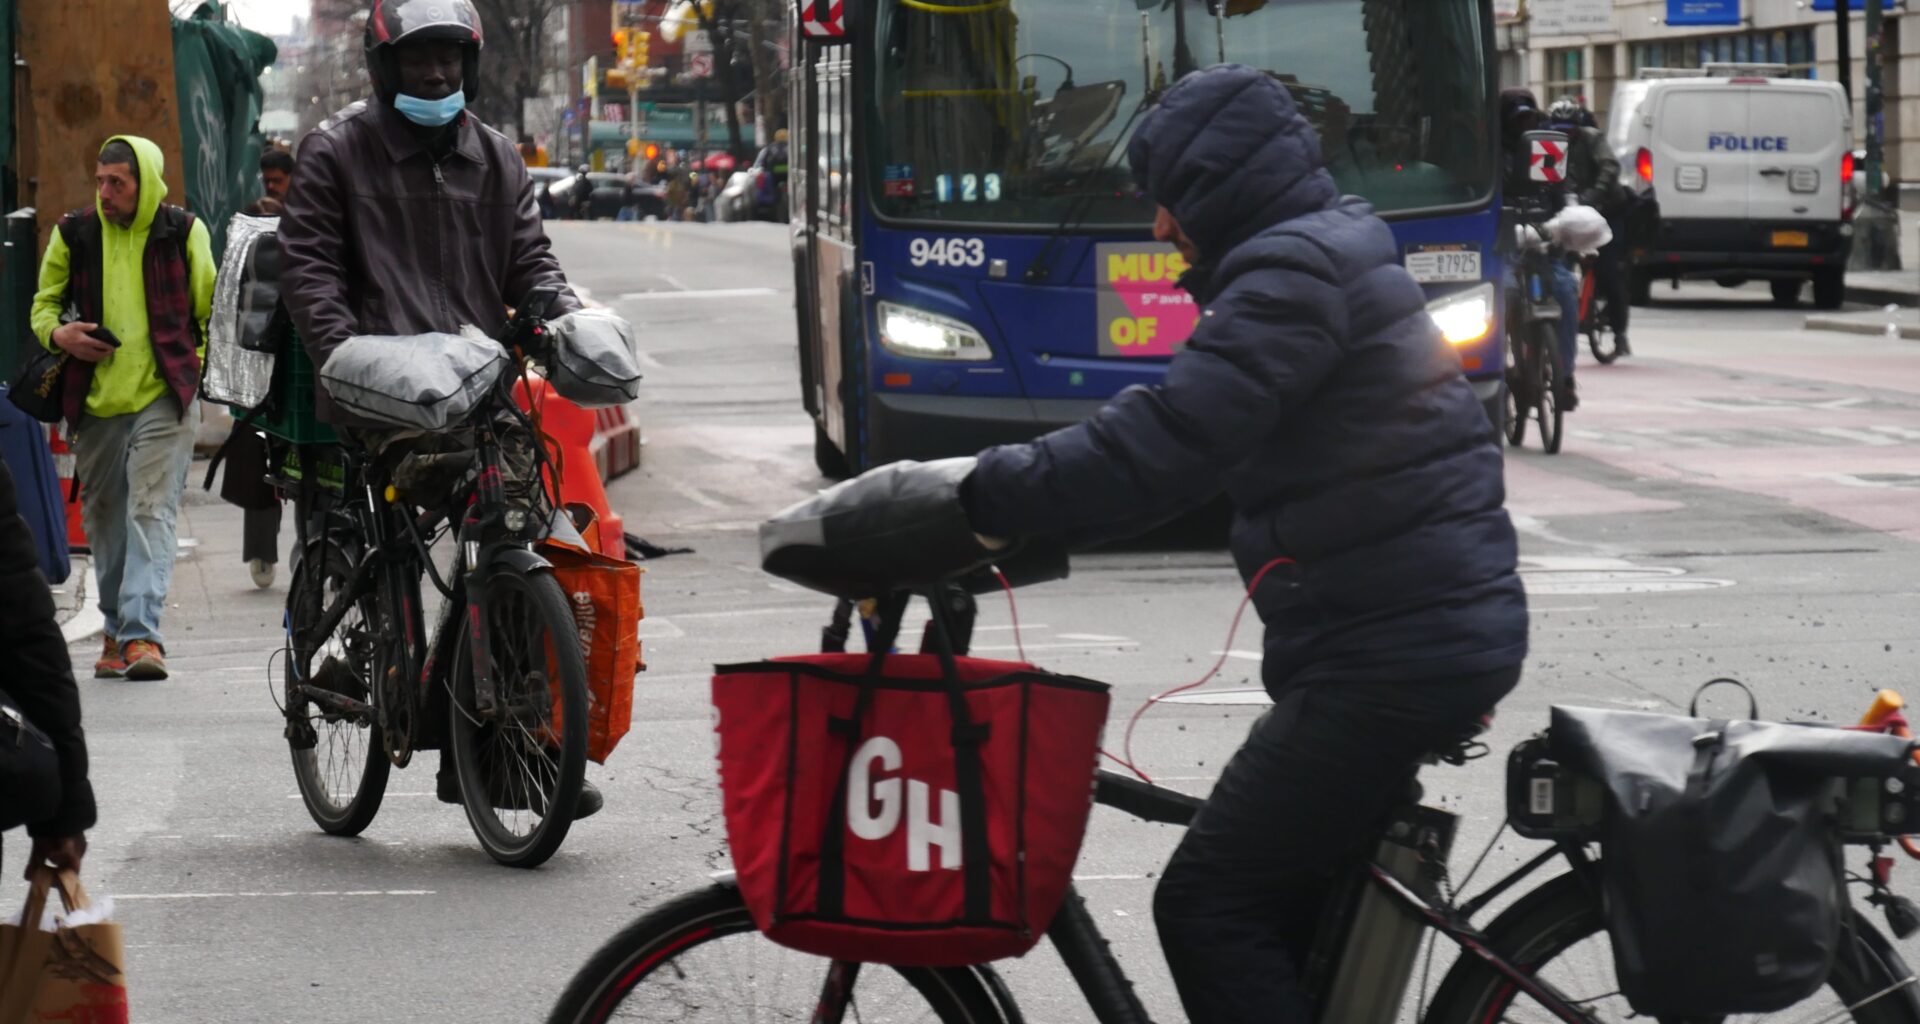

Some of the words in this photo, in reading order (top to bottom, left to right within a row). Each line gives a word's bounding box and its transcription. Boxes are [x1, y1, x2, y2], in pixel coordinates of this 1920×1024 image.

[1708, 136, 1788, 151] POLICE
[909, 238, 985, 267] 9463
[1446, 254, 1476, 273] 7925
[1109, 317, 1157, 346] OF
[847, 736, 963, 872] GH
